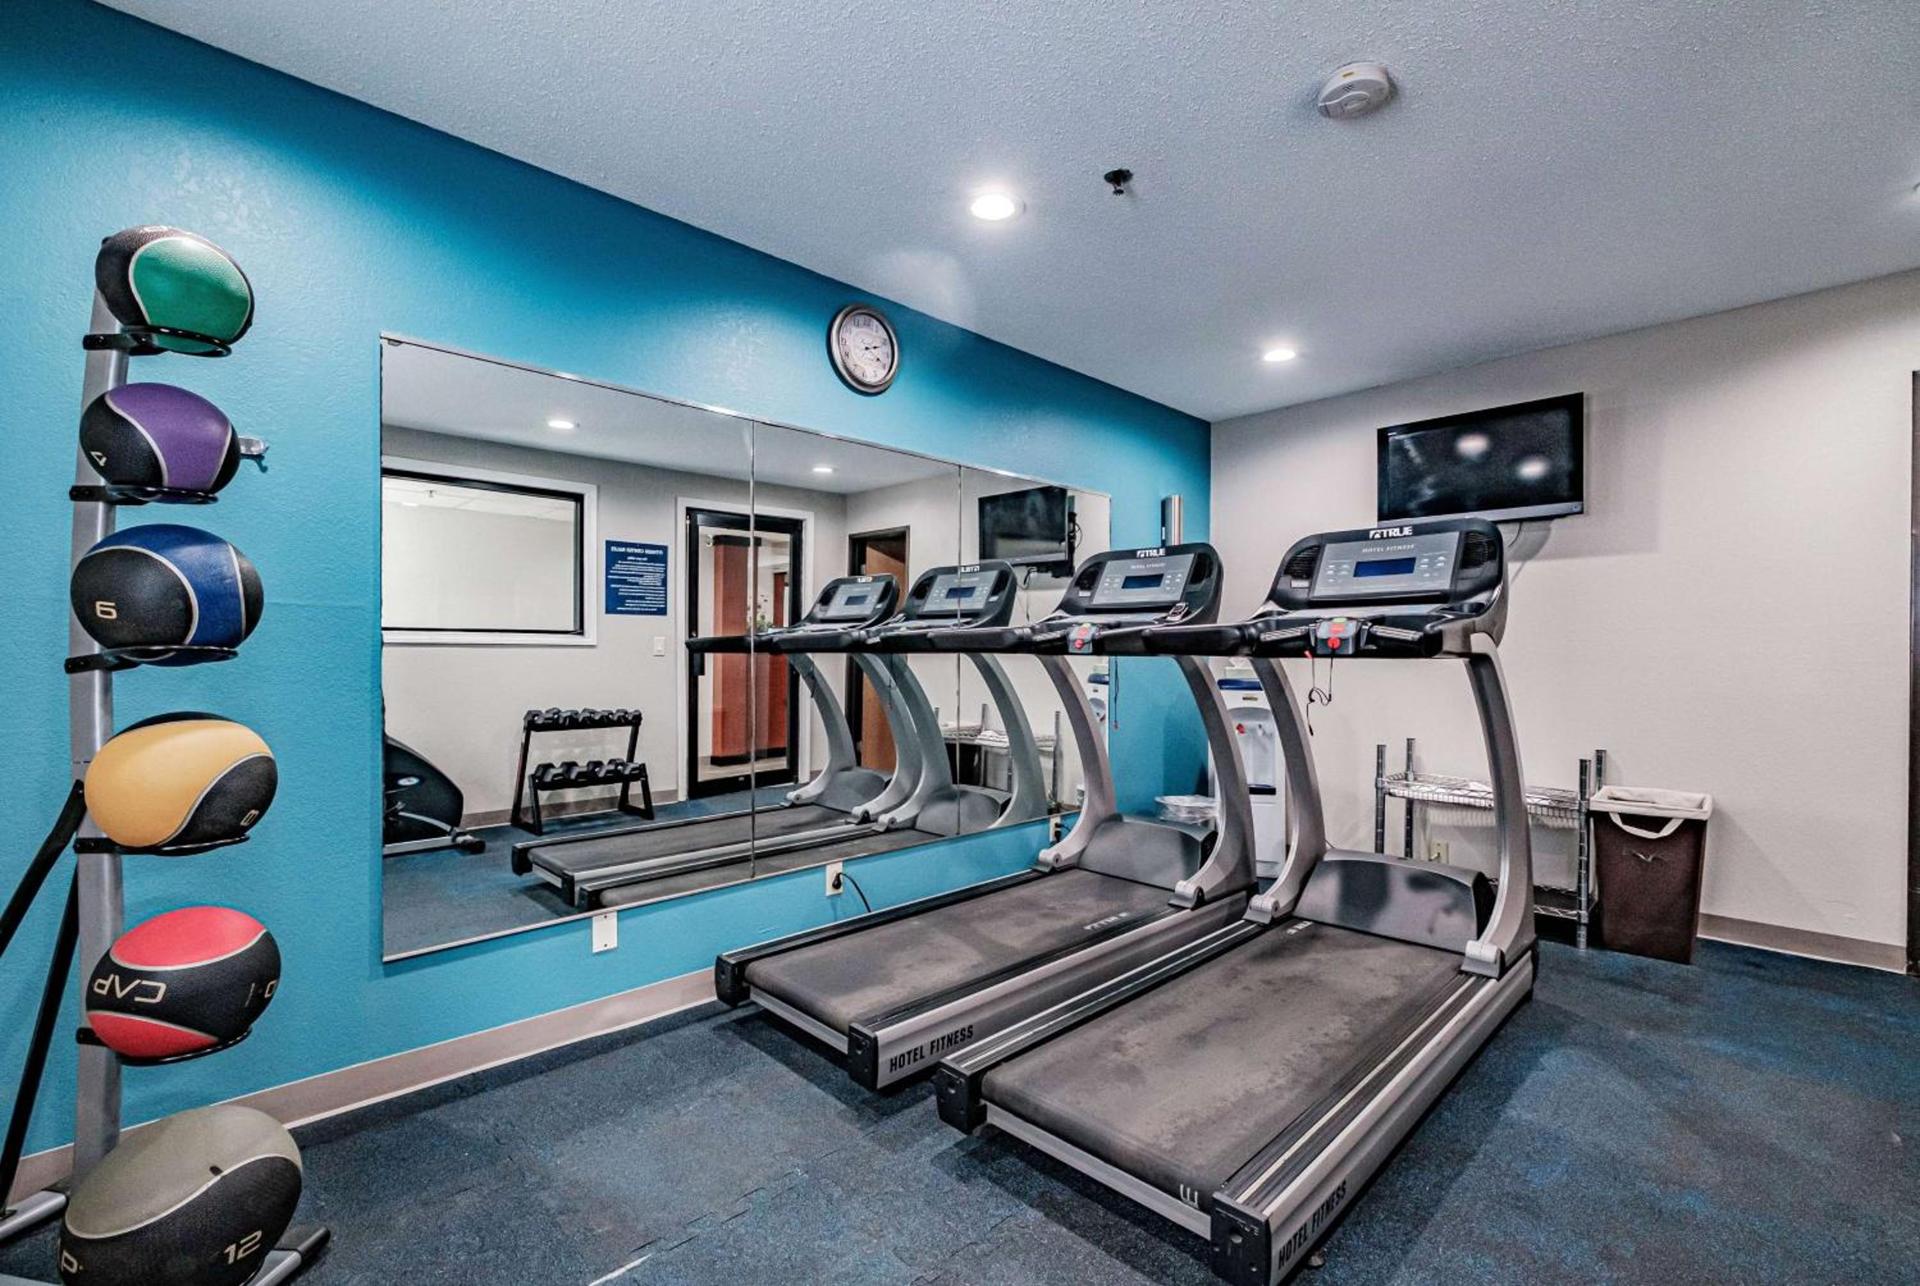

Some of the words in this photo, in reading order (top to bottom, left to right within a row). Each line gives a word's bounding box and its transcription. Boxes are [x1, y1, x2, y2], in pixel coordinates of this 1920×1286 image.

[1382, 526, 1413, 538] TRUE
[95, 601, 118, 619] 6
[93, 973, 167, 1004] CAP
[889, 1045, 925, 1073] HOTEL
[929, 1025, 974, 1055] FITNESS
[1278, 1222, 1307, 1270] HOTEL
[1312, 1177, 1346, 1233] FITNESS
[224, 1230, 262, 1265] 12
